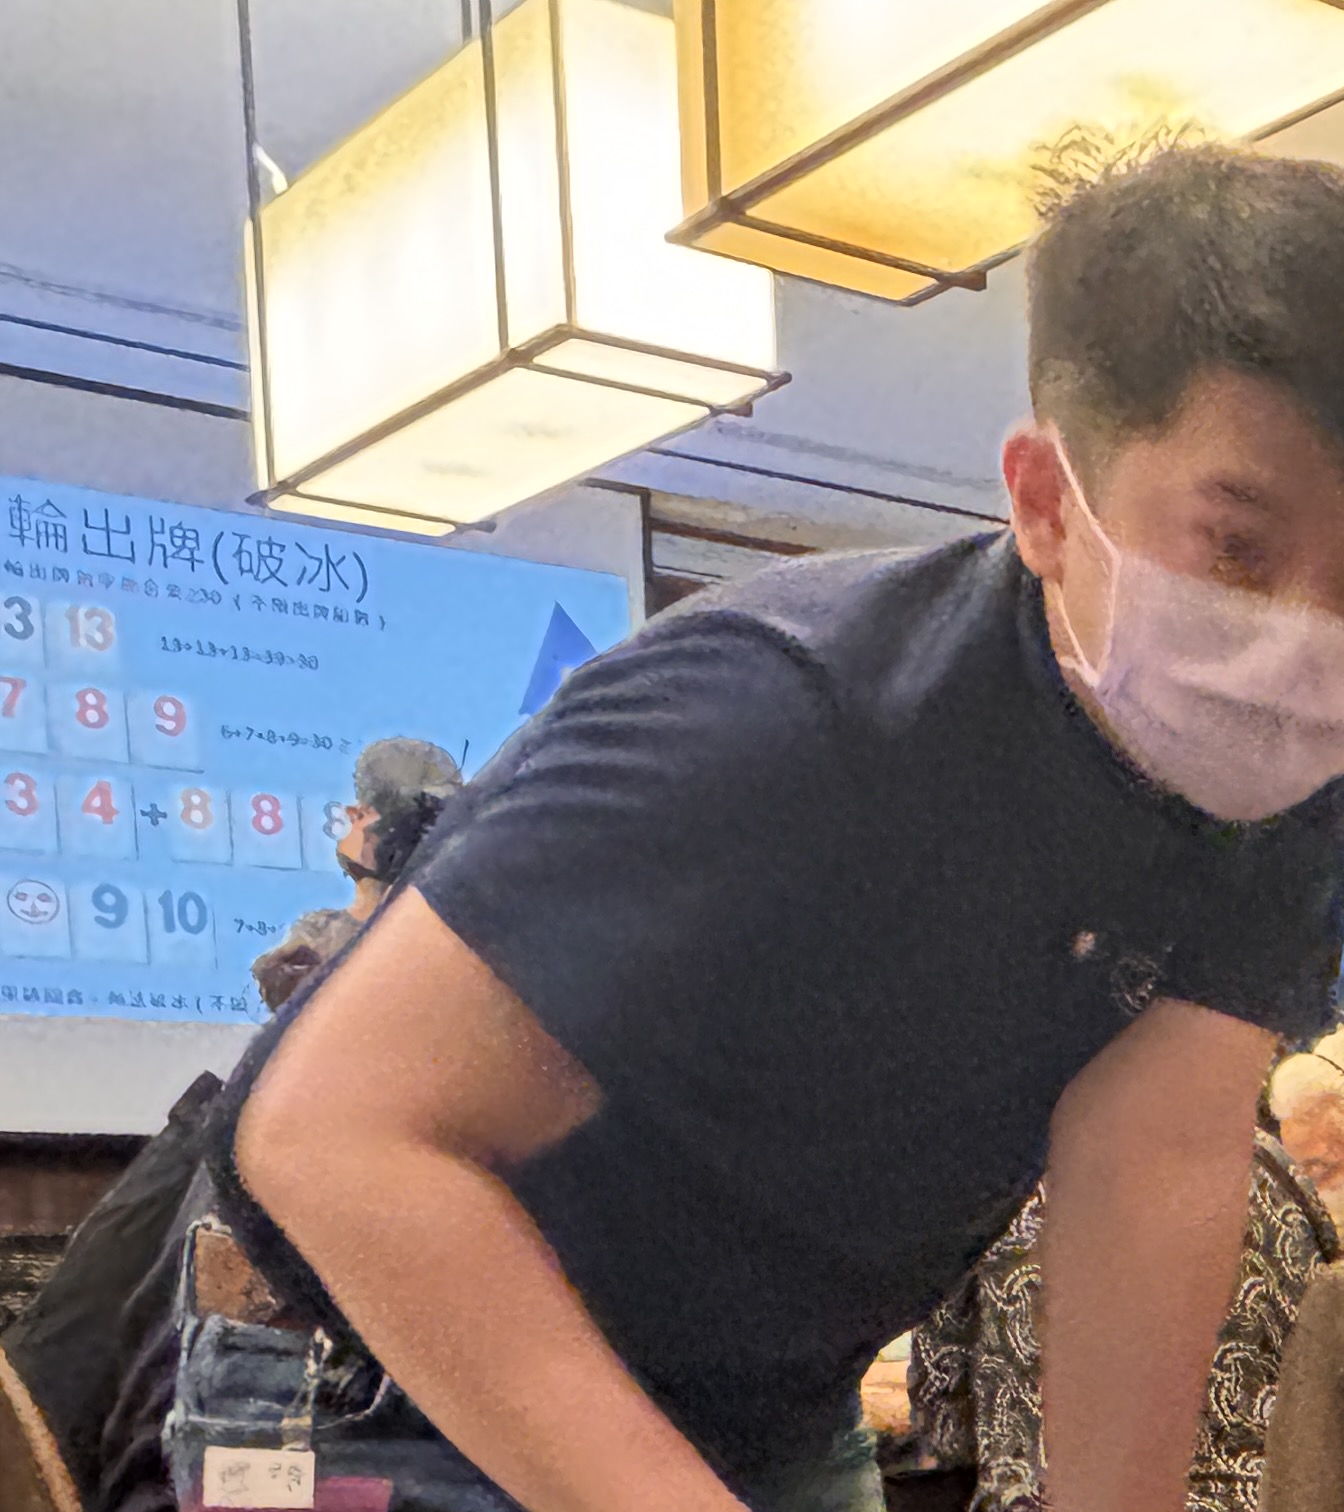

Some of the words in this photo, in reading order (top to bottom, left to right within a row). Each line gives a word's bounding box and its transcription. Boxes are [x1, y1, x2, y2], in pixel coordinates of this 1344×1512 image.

[9, 494, 368, 604] 輪出牌(破冰)
[65, 603, 115, 651] 13
[76, 688, 109, 729] 8
[153, 695, 187, 737] 9
[3, 772, 40, 817] 3
[81, 780, 120, 825] 4
[180, 788, 213, 830] 8
[251, 793, 284, 836] 8
[92, 883, 128, 929] 9
[159, 889, 208, 935] 10
